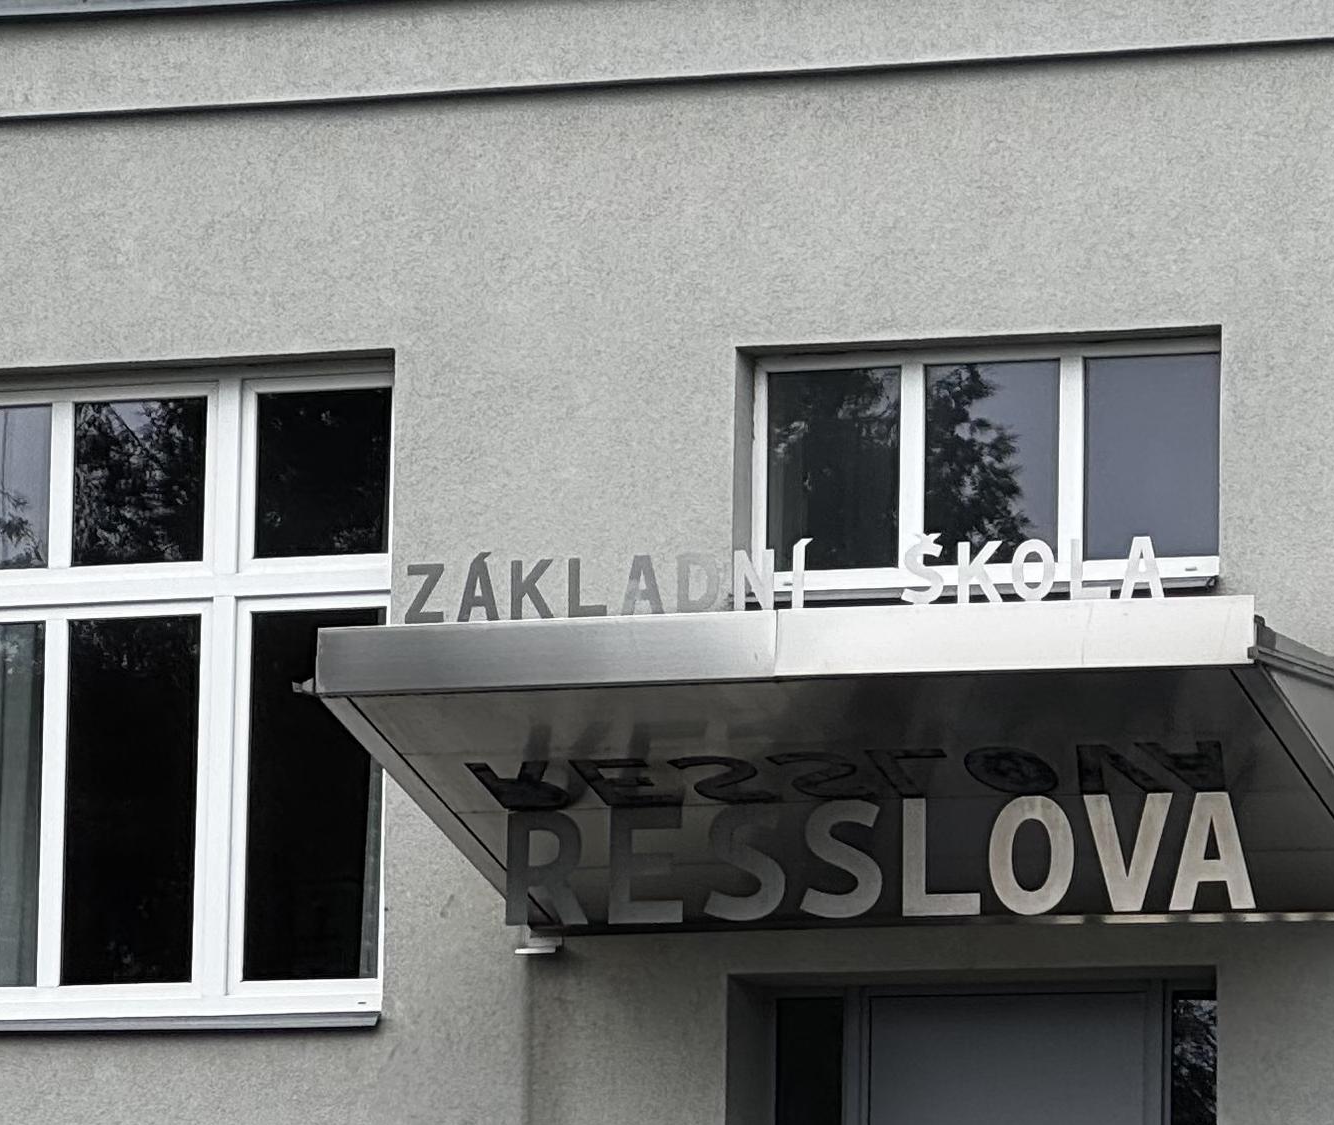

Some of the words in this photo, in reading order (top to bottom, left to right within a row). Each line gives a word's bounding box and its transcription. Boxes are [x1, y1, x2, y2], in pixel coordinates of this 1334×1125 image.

[404, 537, 814, 625] ZÁKLADNÍ
[901, 532, 1166, 606] ŠKOLA
[505, 791, 1257, 926] RESSLOVA
